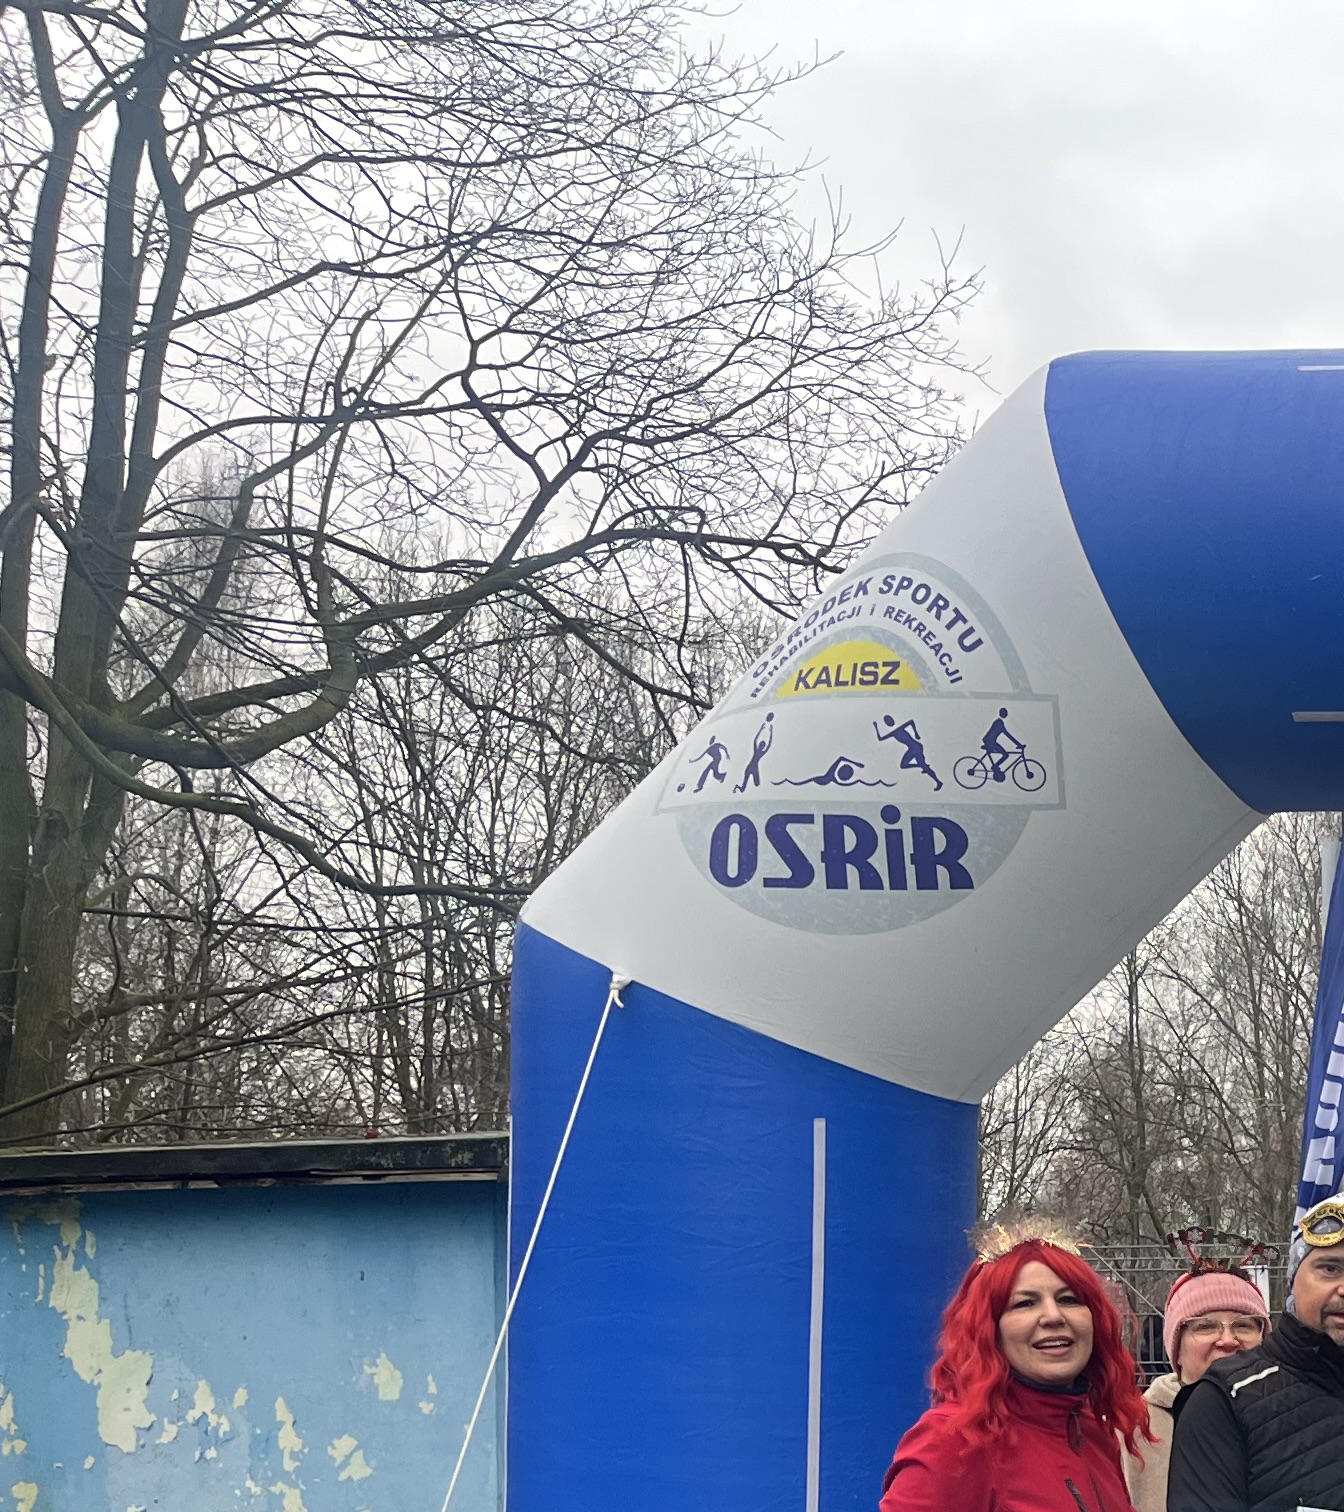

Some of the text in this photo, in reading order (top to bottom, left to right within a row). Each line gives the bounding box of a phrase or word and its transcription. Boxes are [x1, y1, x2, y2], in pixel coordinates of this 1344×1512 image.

[749, 605, 863, 699] REHABILITACJI
[882, 605, 963, 684] REKREACJI
[878, 574, 984, 653] SPORTU
[793, 660, 901, 692] KALISZ
